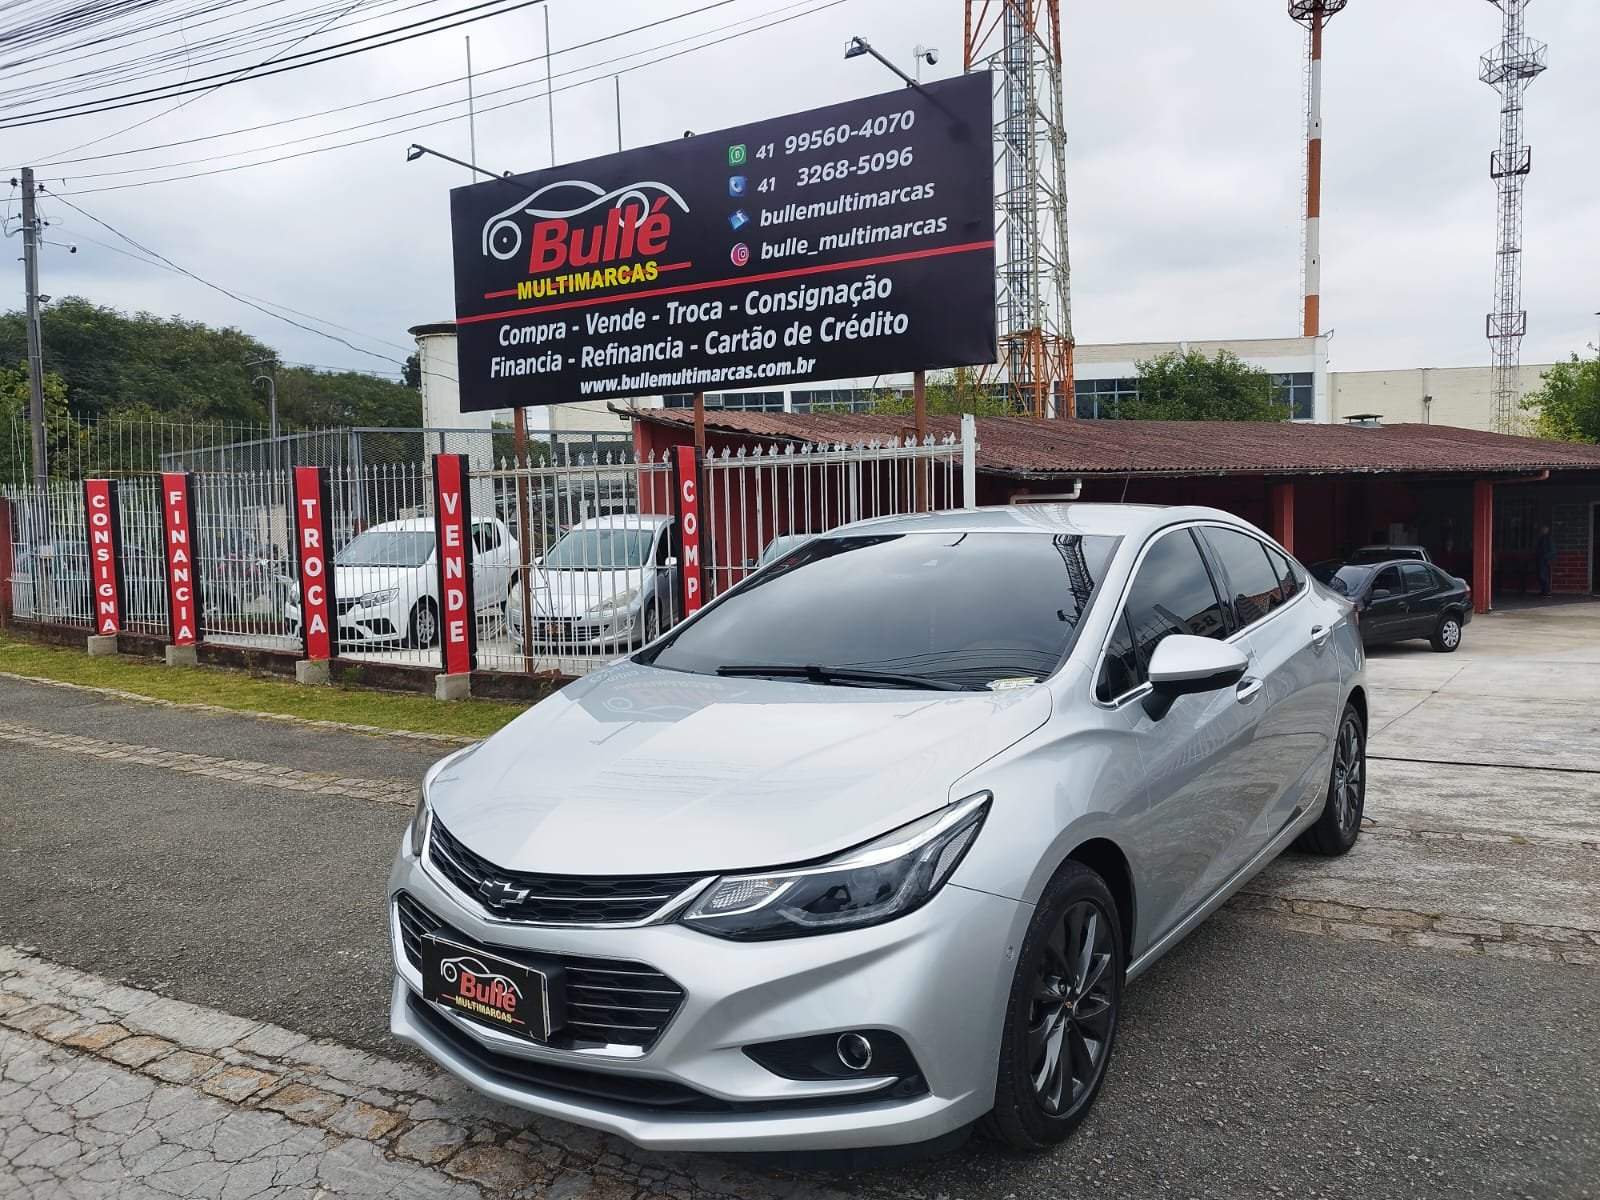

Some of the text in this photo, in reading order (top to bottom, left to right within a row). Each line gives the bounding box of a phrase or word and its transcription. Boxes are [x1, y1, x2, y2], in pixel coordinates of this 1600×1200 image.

[756, 110, 915, 160] 41 99560-4070
[757, 146, 914, 193] 41 3268-5096
[760, 182, 935, 227] bullemultimarcas
[529, 196, 671, 274] Bullé
[760, 216, 948, 260] bulle_multimarcas
[517, 260, 659, 300] MULTIMARCAS
[499, 321, 566, 347] Compra
[586, 307, 646, 336] Vende
[666, 300, 723, 326] Troca
[745, 273, 893, 316] Consignação
[490, 350, 563, 379] Financia
[581, 336, 684, 369] Refinancia
[705, 325, 777, 355] Cartão
[783, 321, 813, 346] de
[820, 310, 909, 342] Crédito
[580, 356, 816, 395] www.bullemultimarcas.com.br
[92, 495, 117, 633] CONSIGNA
[169, 491, 193, 640] FINANCIA
[301, 498, 327, 635] TROCA
[442, 492, 465, 643] VENDE
[682, 479, 699, 617] COMP
[455, 995, 513, 1023] MULTIMARCAS
[460, 971, 517, 1012] Bullé
